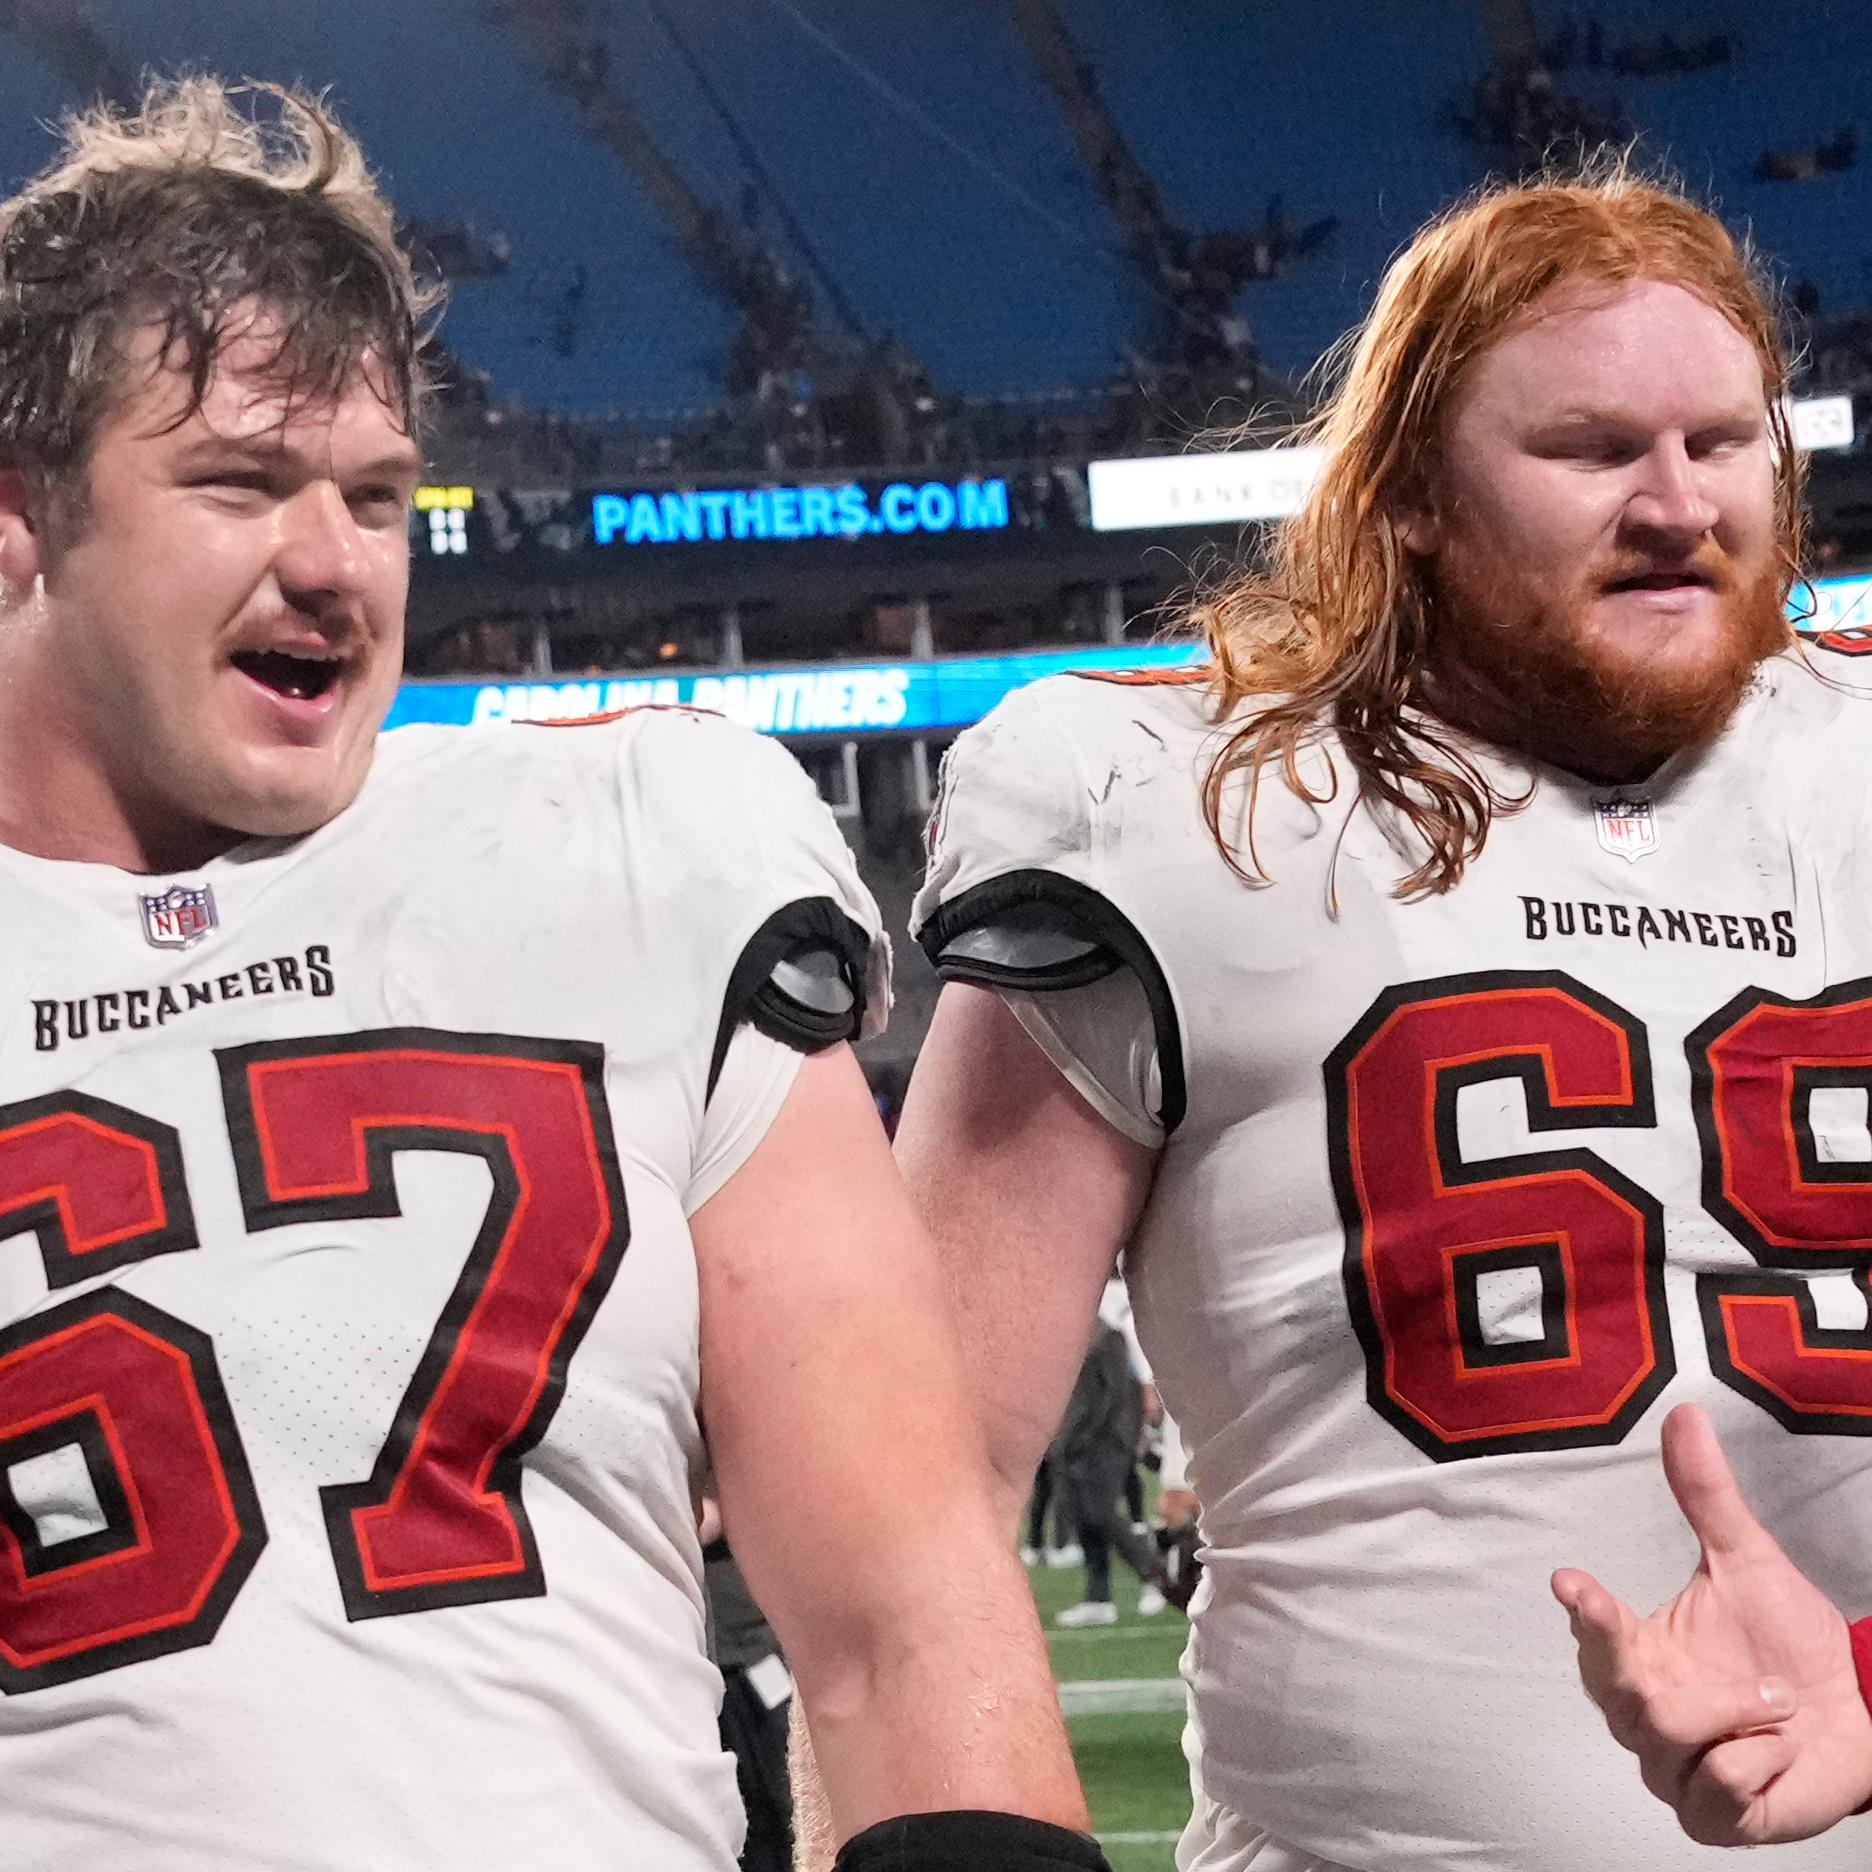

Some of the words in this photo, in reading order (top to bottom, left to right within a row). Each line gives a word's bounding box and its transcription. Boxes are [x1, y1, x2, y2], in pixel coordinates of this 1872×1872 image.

[591, 478, 1010, 545] PANTHERS.COM
[153, 906, 209, 937] NFL
[1518, 896, 1796, 957] BUCCANEERS
[32, 945, 335, 1051] BUCCANEERS
